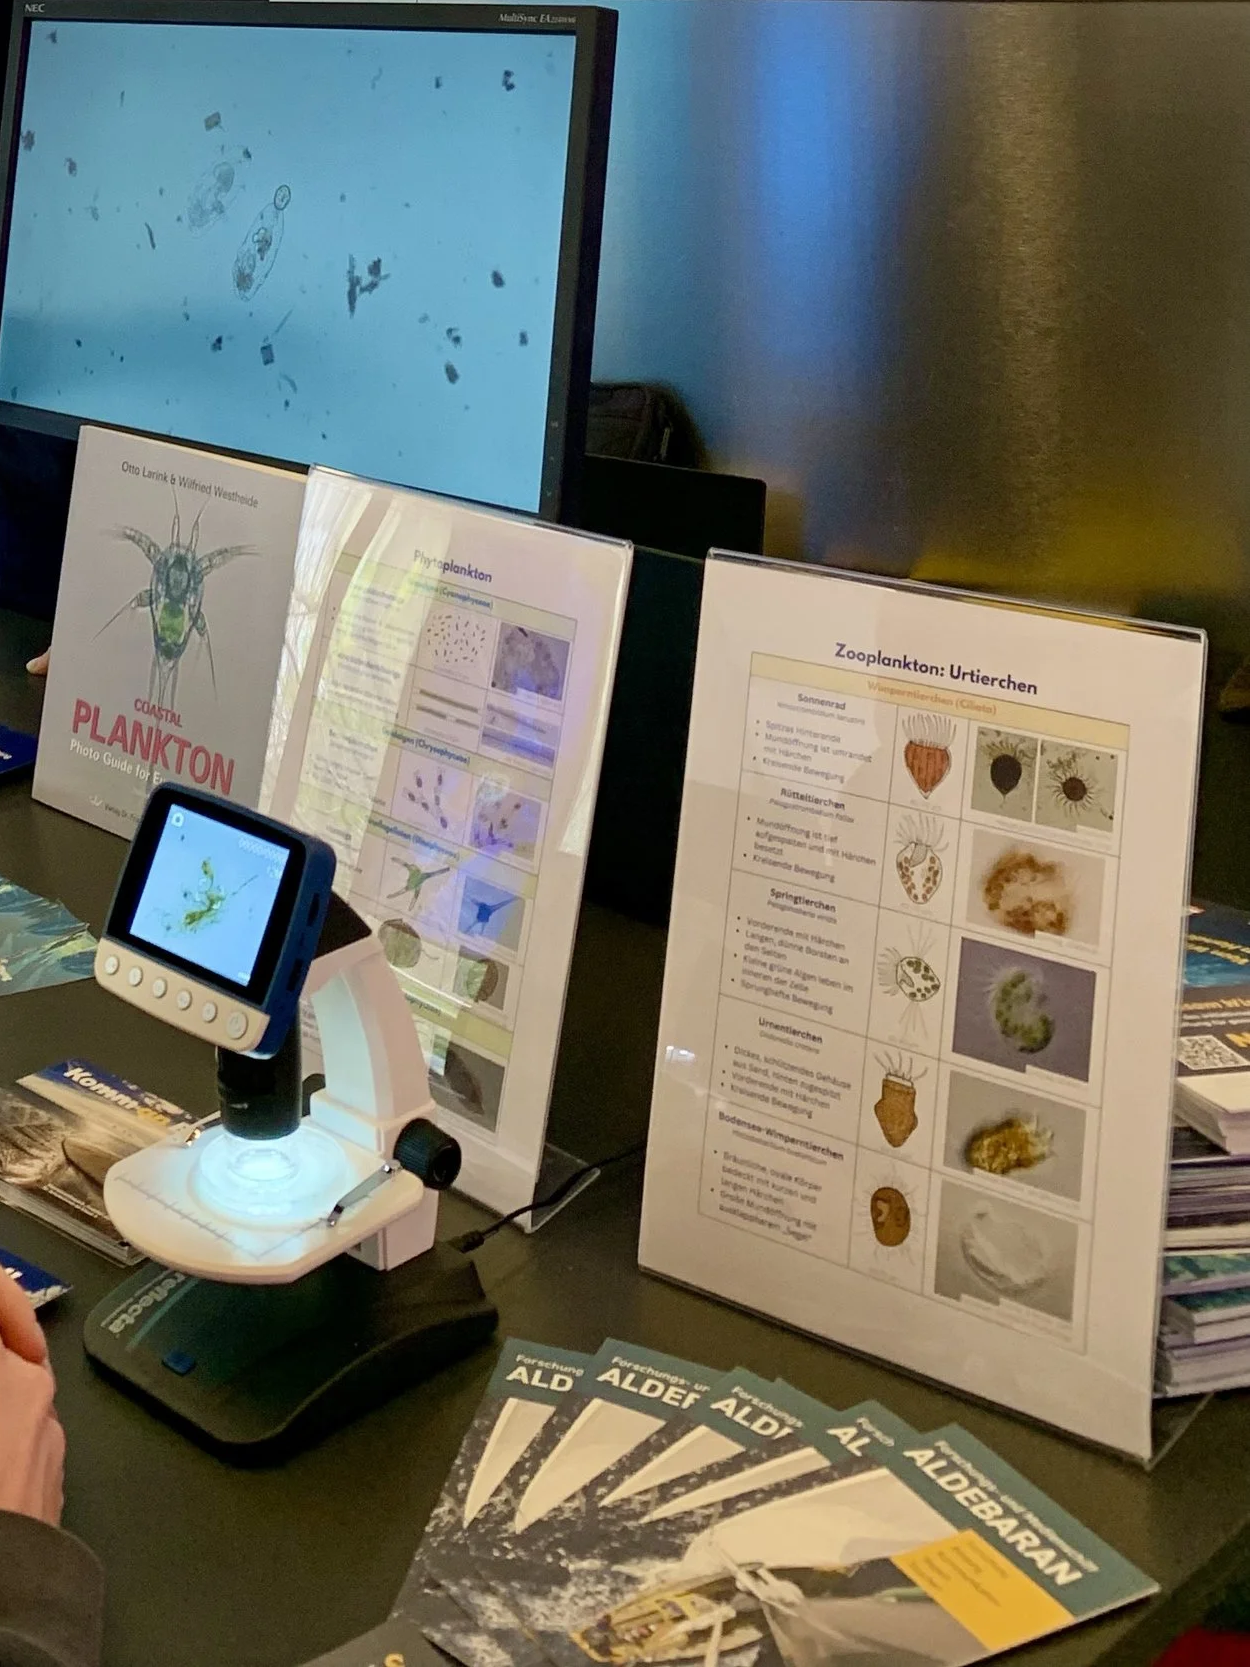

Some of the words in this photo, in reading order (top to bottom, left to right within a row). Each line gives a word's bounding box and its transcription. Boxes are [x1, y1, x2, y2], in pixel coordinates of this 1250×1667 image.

[25, 3, 46, 13] NEC
[121, 461, 141, 476] Otto
[142, 466, 169, 483] Larink
[170, 473, 177, 485] &
[179, 475, 212, 495] Wilfried
[213, 486, 259, 508] Westheide
[413, 549, 492, 583] Phytoplankton
[834, 642, 945, 677] Zooplankton:
[949, 664, 1038, 696] Urtierchen
[798, 693, 847, 710] Sonnenrad
[867, 680, 954, 707] Wimperntierchen
[134, 698, 183, 728] COASTAL
[70, 738, 100, 762] Photo
[103, 752, 133, 775] Guide
[135, 764, 151, 781] for
[72, 697, 235, 796] PLANKTON
[780, 788, 845, 810] Rütteltierchen
[752, 854, 792, 871] Kreisende
[793, 864, 835, 883] Bewegung
[770, 887, 836, 913] Springtierchen
[747, 917, 794, 937] Vorderende
[792, 992, 834, 1016] Bewegung
[758, 1016, 823, 1044] Urnentierchen
[63, 1066, 139, 1111] Komm
[108, 1271, 186, 1333] reflecta
[505, 1365, 574, 1393] ALD
[515, 1354, 585, 1377] Forschung
[611, 1355, 692, 1386] Forschungs-
[903, 1447, 1083, 1586] ALDEBARAN
